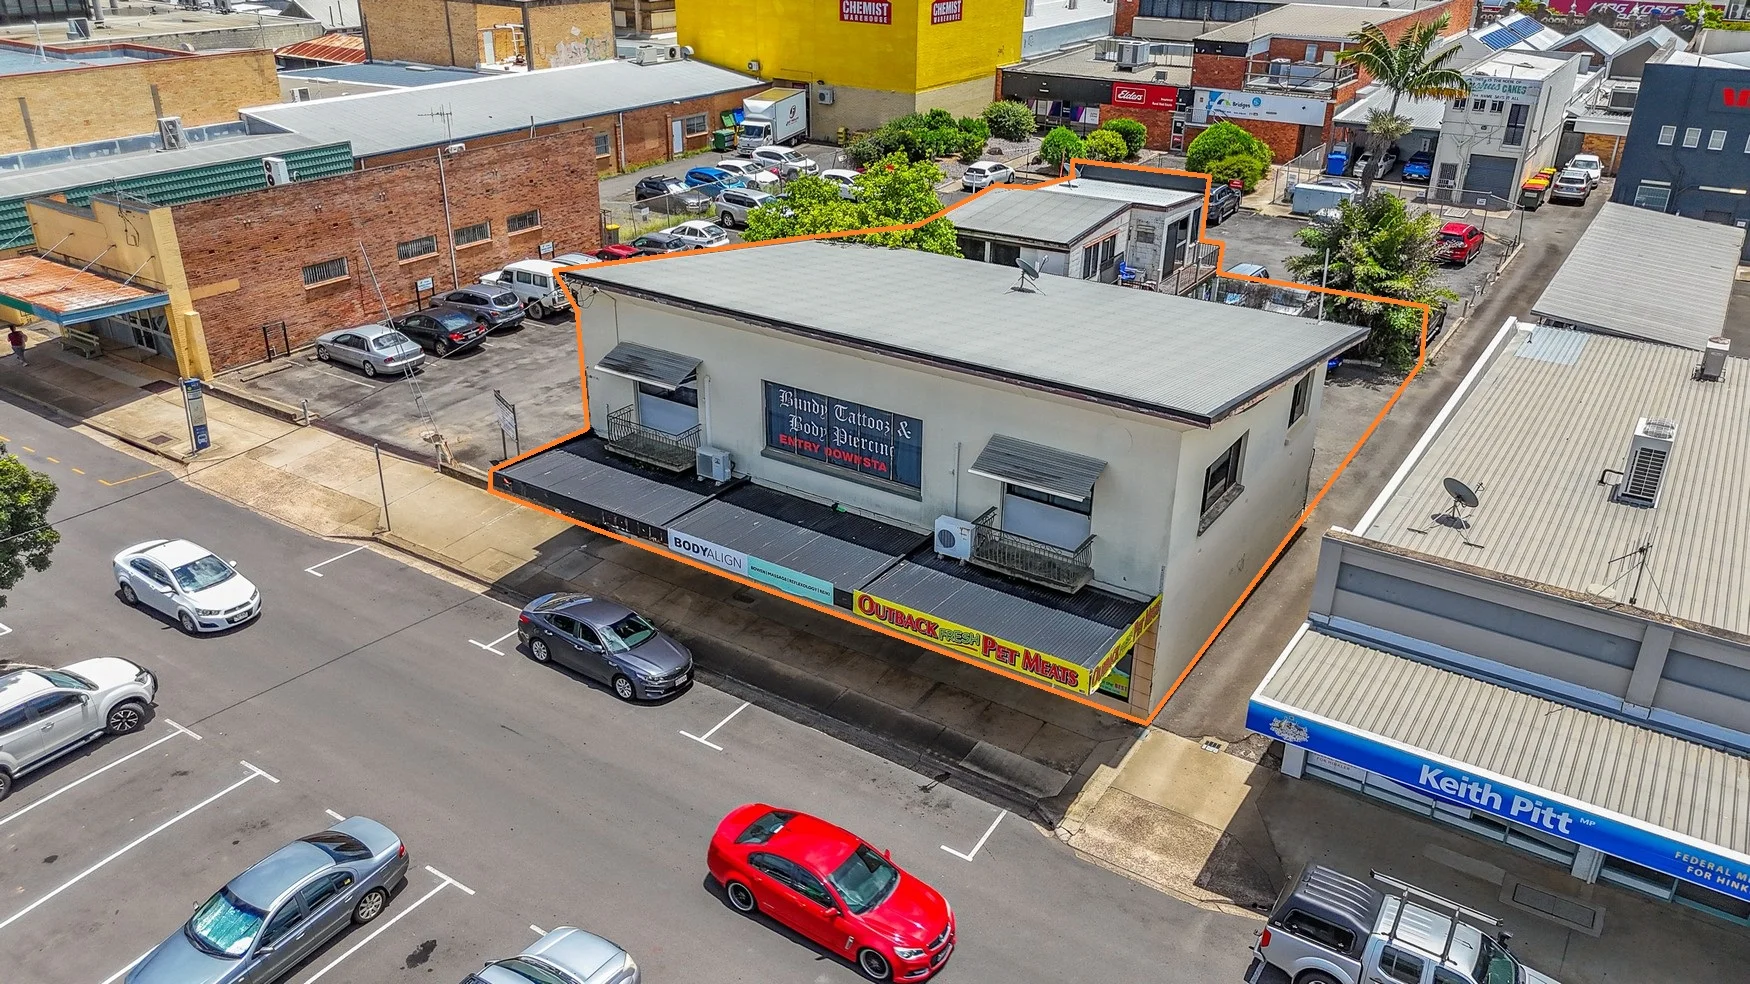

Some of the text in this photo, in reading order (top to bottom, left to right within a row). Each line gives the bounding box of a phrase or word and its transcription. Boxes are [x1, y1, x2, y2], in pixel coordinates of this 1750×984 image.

[843, 0, 889, 16] CHEMIST
[933, 1, 961, 16] CHEMIST
[844, 14, 888, 23] WAREHOUSE
[1117, 90, 1144, 101] Elders
[1502, 84, 1527, 95] CAKES
[1232, 101, 1251, 109] Bridges
[779, 389, 912, 439] Bundy Tattooz &
[788, 414, 827, 442] Body
[779, 433, 821, 453] ENTRY
[767, 571, 788, 582] MASSAGE
[789, 578, 818, 592] REFLEXOLOGY
[857, 594, 1079, 688] OUTBACK FRESH PET MEATS
[1418, 764, 1596, 835] Keith Pitt MP
[1674, 851, 1750, 884] FEDERAL M
[1686, 866, 1750, 895] FOR HINK
